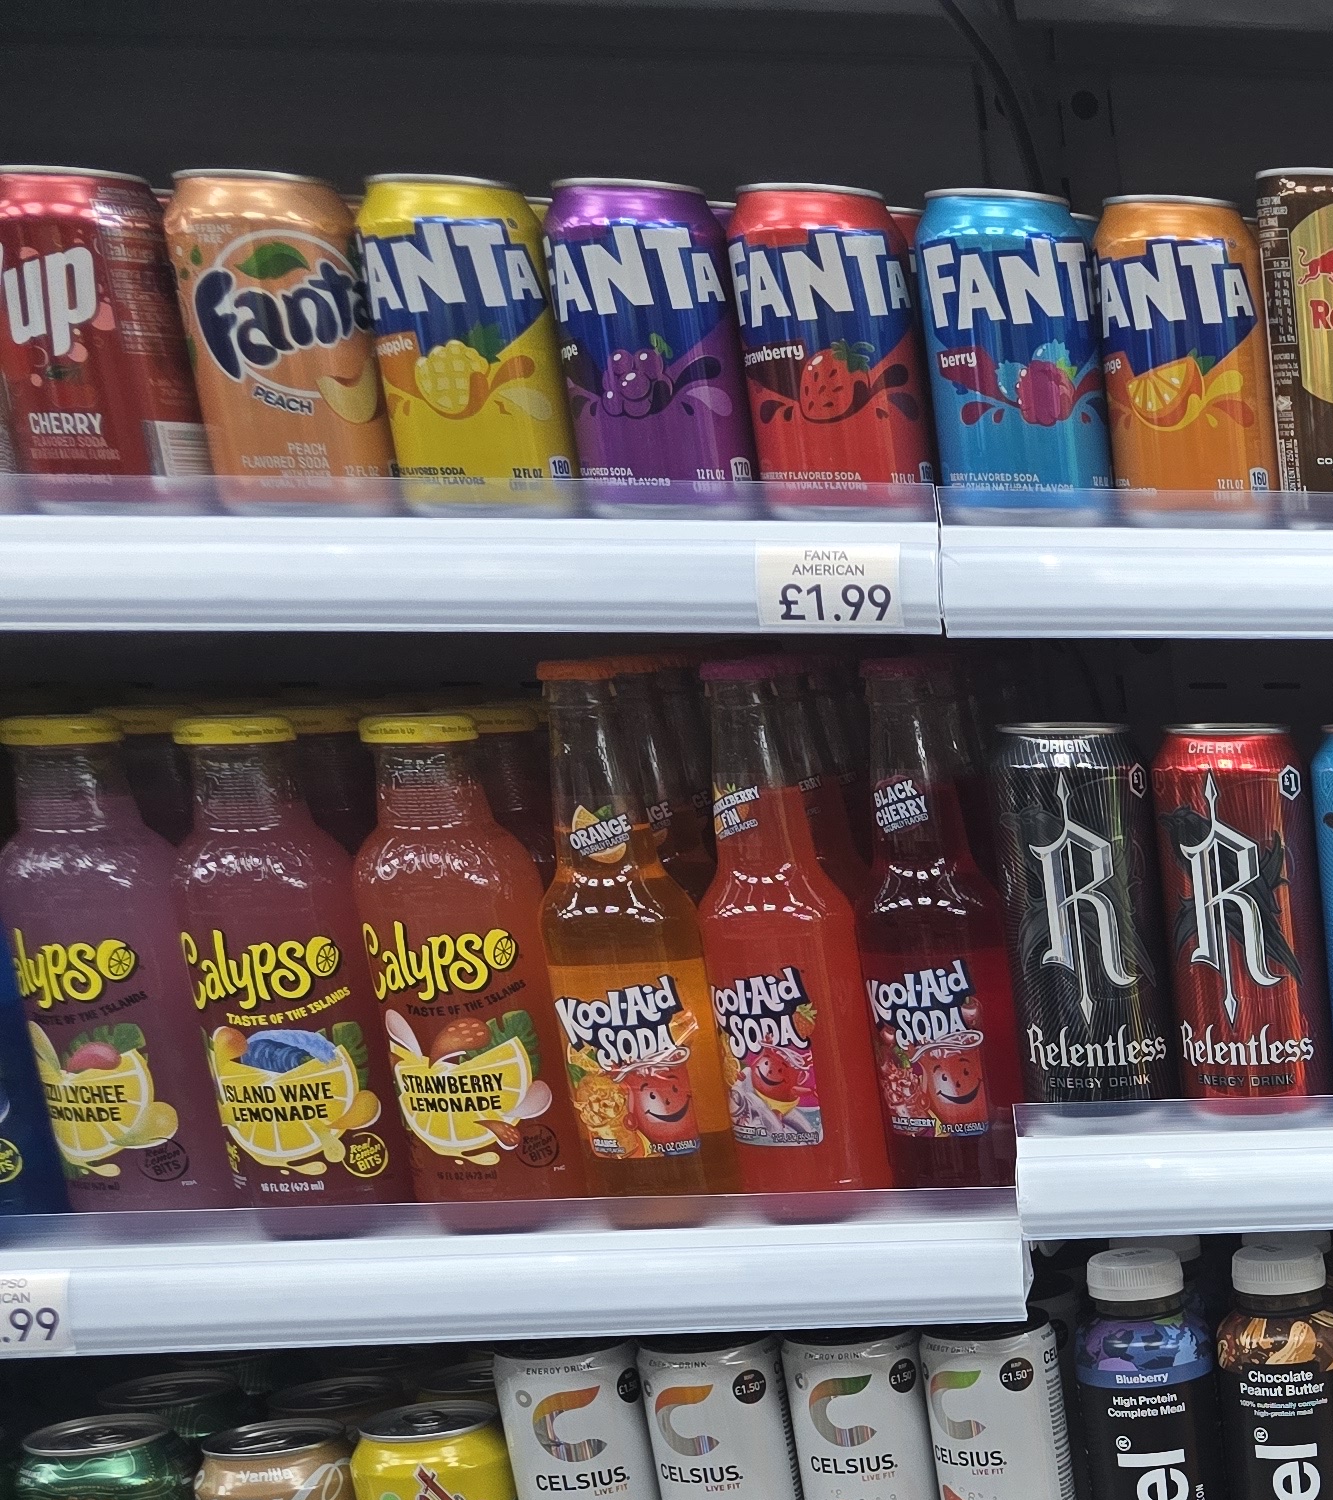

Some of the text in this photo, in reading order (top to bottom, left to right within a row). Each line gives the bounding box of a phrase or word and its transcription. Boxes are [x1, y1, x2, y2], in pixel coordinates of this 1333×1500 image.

[941, 351, 976, 368] berry
[253, 386, 313, 415] PEACH
[28, 413, 103, 435] CHERRY
[804, 550, 848, 562] FANTA
[792, 564, 865, 576] AMERICAN
[778, 584, 892, 621] £1.99
[1188, 741, 1242, 754] CHERRY
[874, 780, 916, 807] BLACK
[876, 796, 926, 825] CHERRY
[570, 814, 631, 851] ORANGE
[181, 930, 338, 1009] Calypso
[226, 986, 351, 1027] TASTE OF THE ISLANDS
[556, 975, 676, 1045] Kool-Aid
[1026, 1024, 1166, 1069] Relentless
[224, 1082, 333, 1104] ISLAND WAVE
[233, 1104, 328, 1122] LEMONADE
[1116, 1373, 1168, 1385] Blueberry
[1248, 1371, 1313, 1384] Chocolate
[1240, 1381, 1324, 1397] Peanut Butter
[1113, 1393, 1177, 1407] High Protein
[1108, 1403, 1186, 1419] Complete Meal
[239, 1468, 292, 1482] Vanilla
